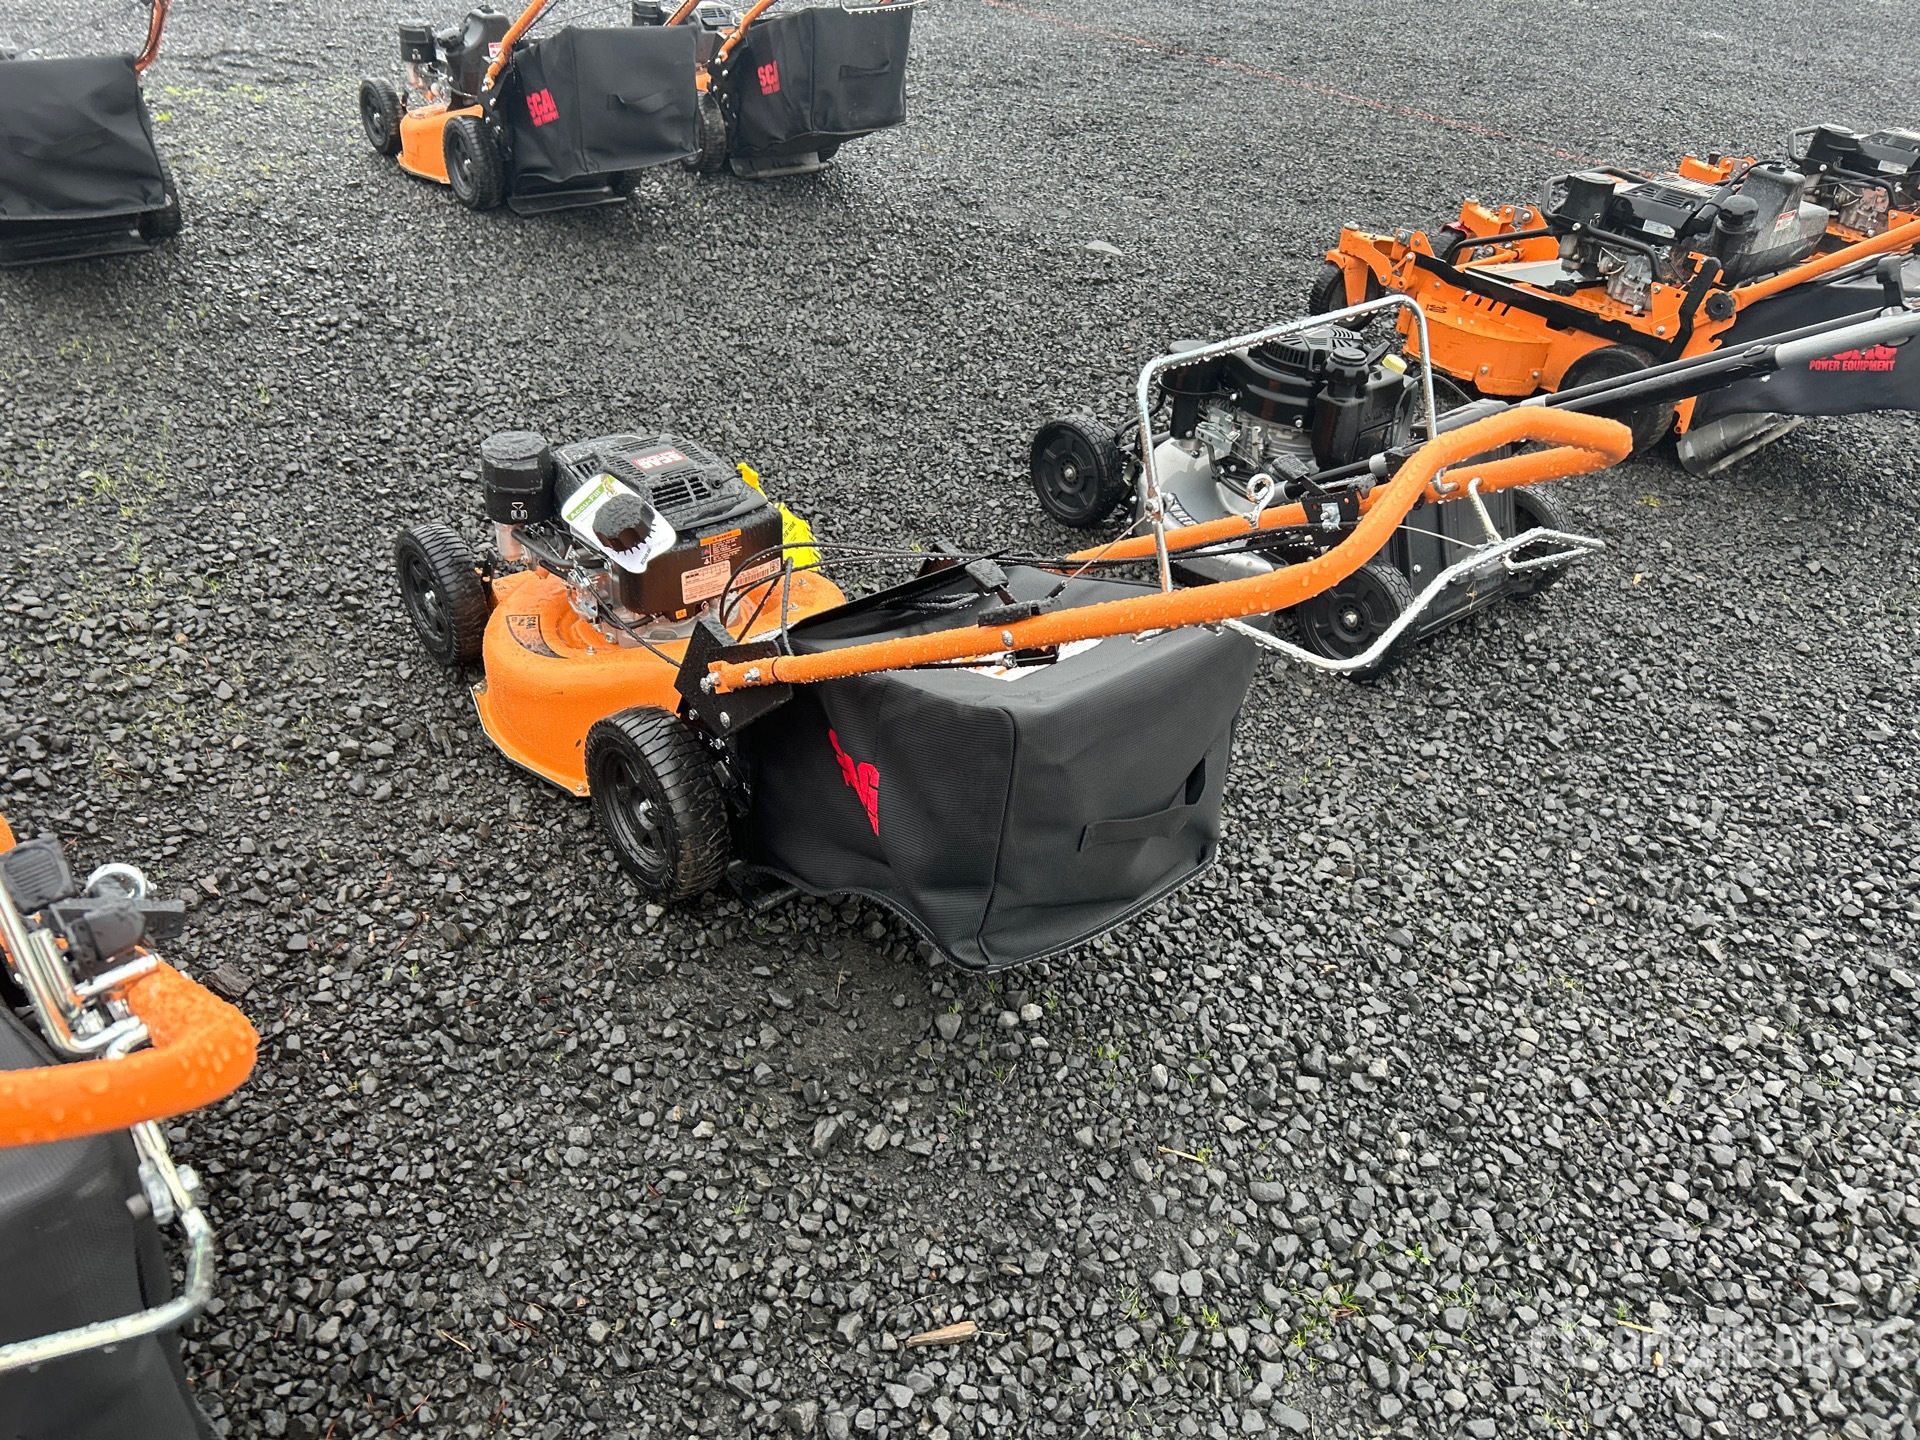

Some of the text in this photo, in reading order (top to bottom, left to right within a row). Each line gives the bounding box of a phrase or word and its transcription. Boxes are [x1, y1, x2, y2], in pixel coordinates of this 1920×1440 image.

[526, 88, 556, 118] SCA
[1809, 360, 1896, 372] POWER EQUIPMENT
[570, 488, 601, 520] Accu-Fill
